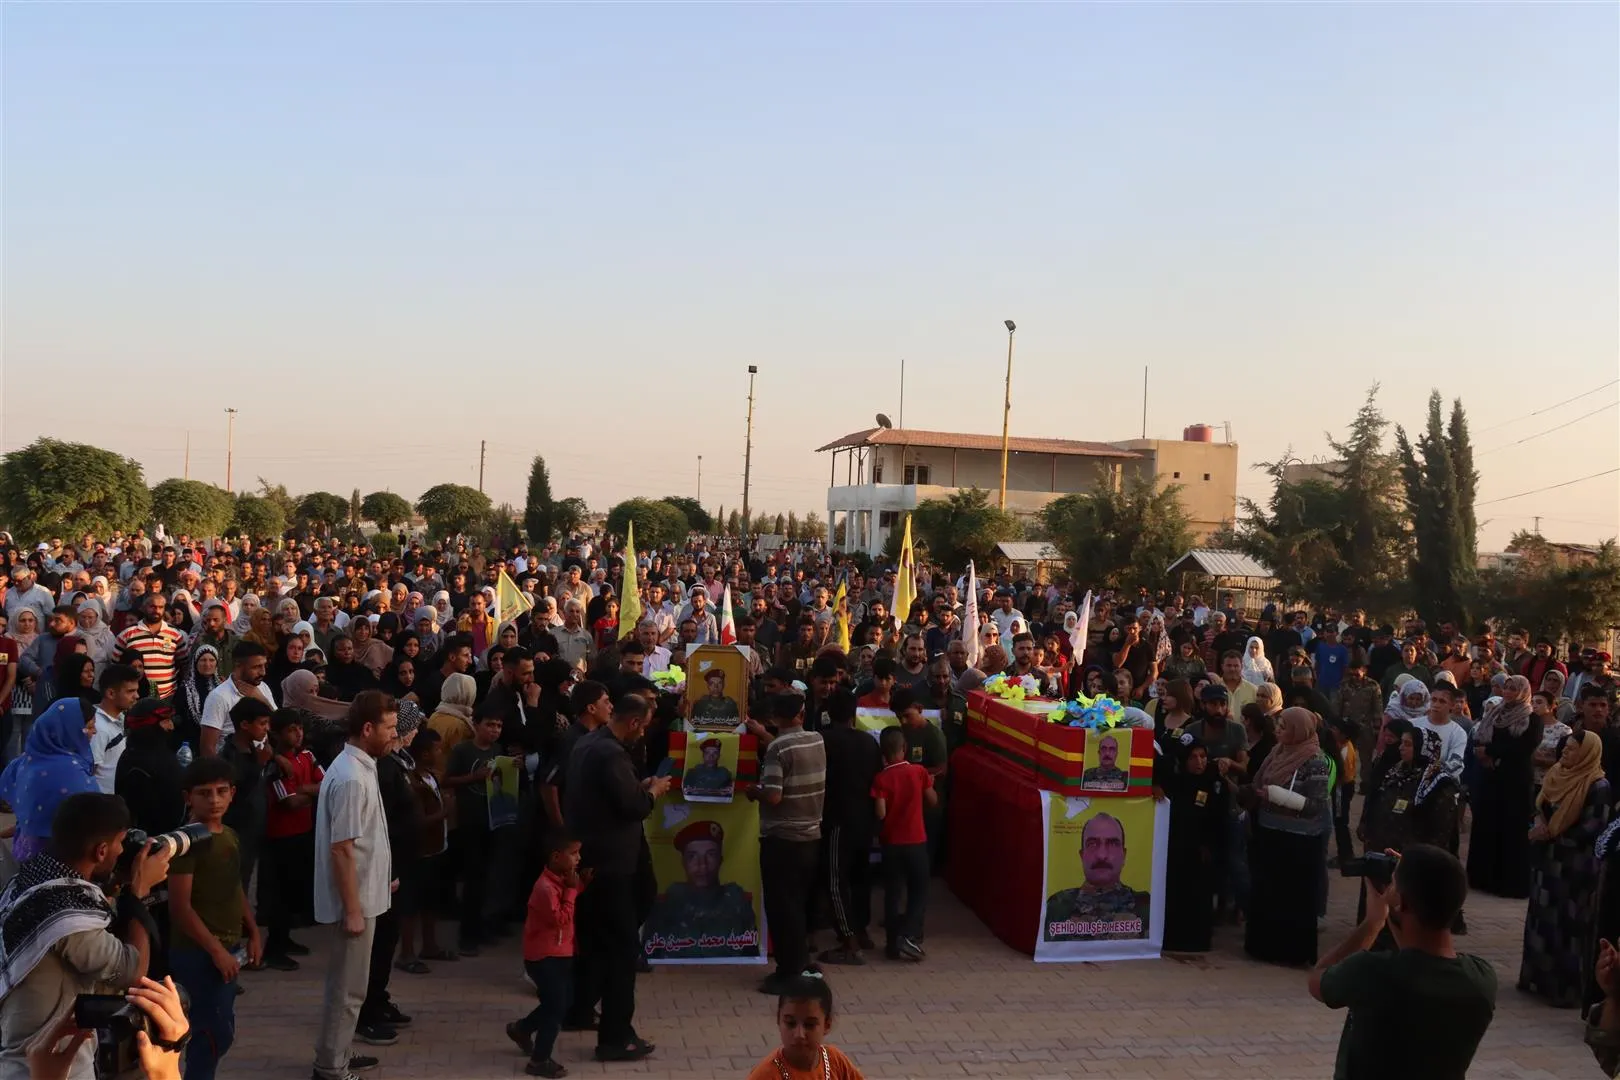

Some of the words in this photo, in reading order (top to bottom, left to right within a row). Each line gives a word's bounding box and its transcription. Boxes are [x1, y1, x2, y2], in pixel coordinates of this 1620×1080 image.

[665, 933, 697, 951] حسين
[697, 933, 725, 948] محمد
[726, 929, 758, 950] الشهيد
